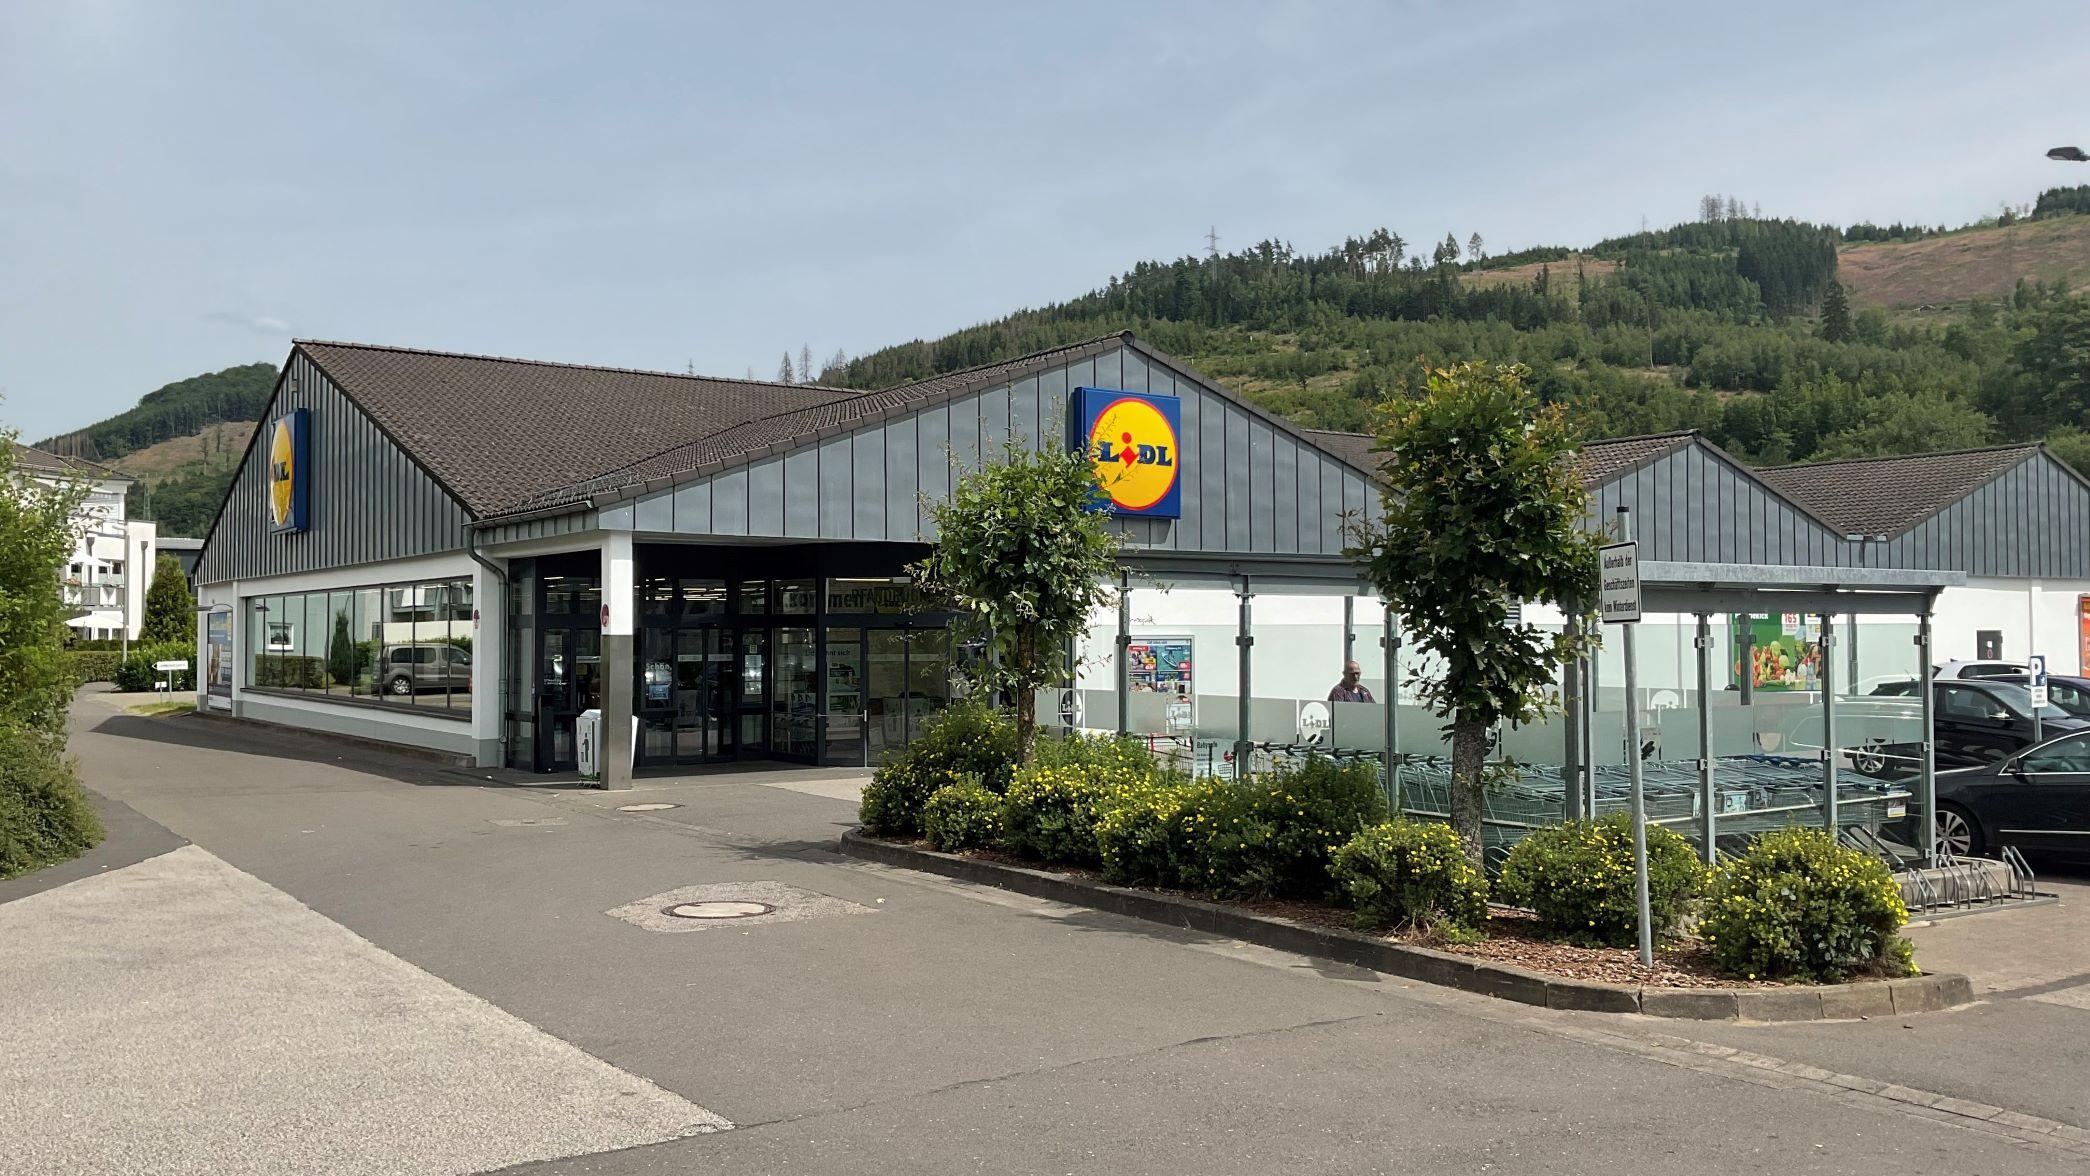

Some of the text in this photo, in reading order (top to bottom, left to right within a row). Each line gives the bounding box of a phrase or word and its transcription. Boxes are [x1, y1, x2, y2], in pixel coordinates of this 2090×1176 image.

[1604, 554, 1624, 569] Außerhalb
[1604, 577, 1635, 591] Geschäftszeiten
[1613, 599, 1637, 612] Winterdienst
[2031, 658, 2042, 686] P
